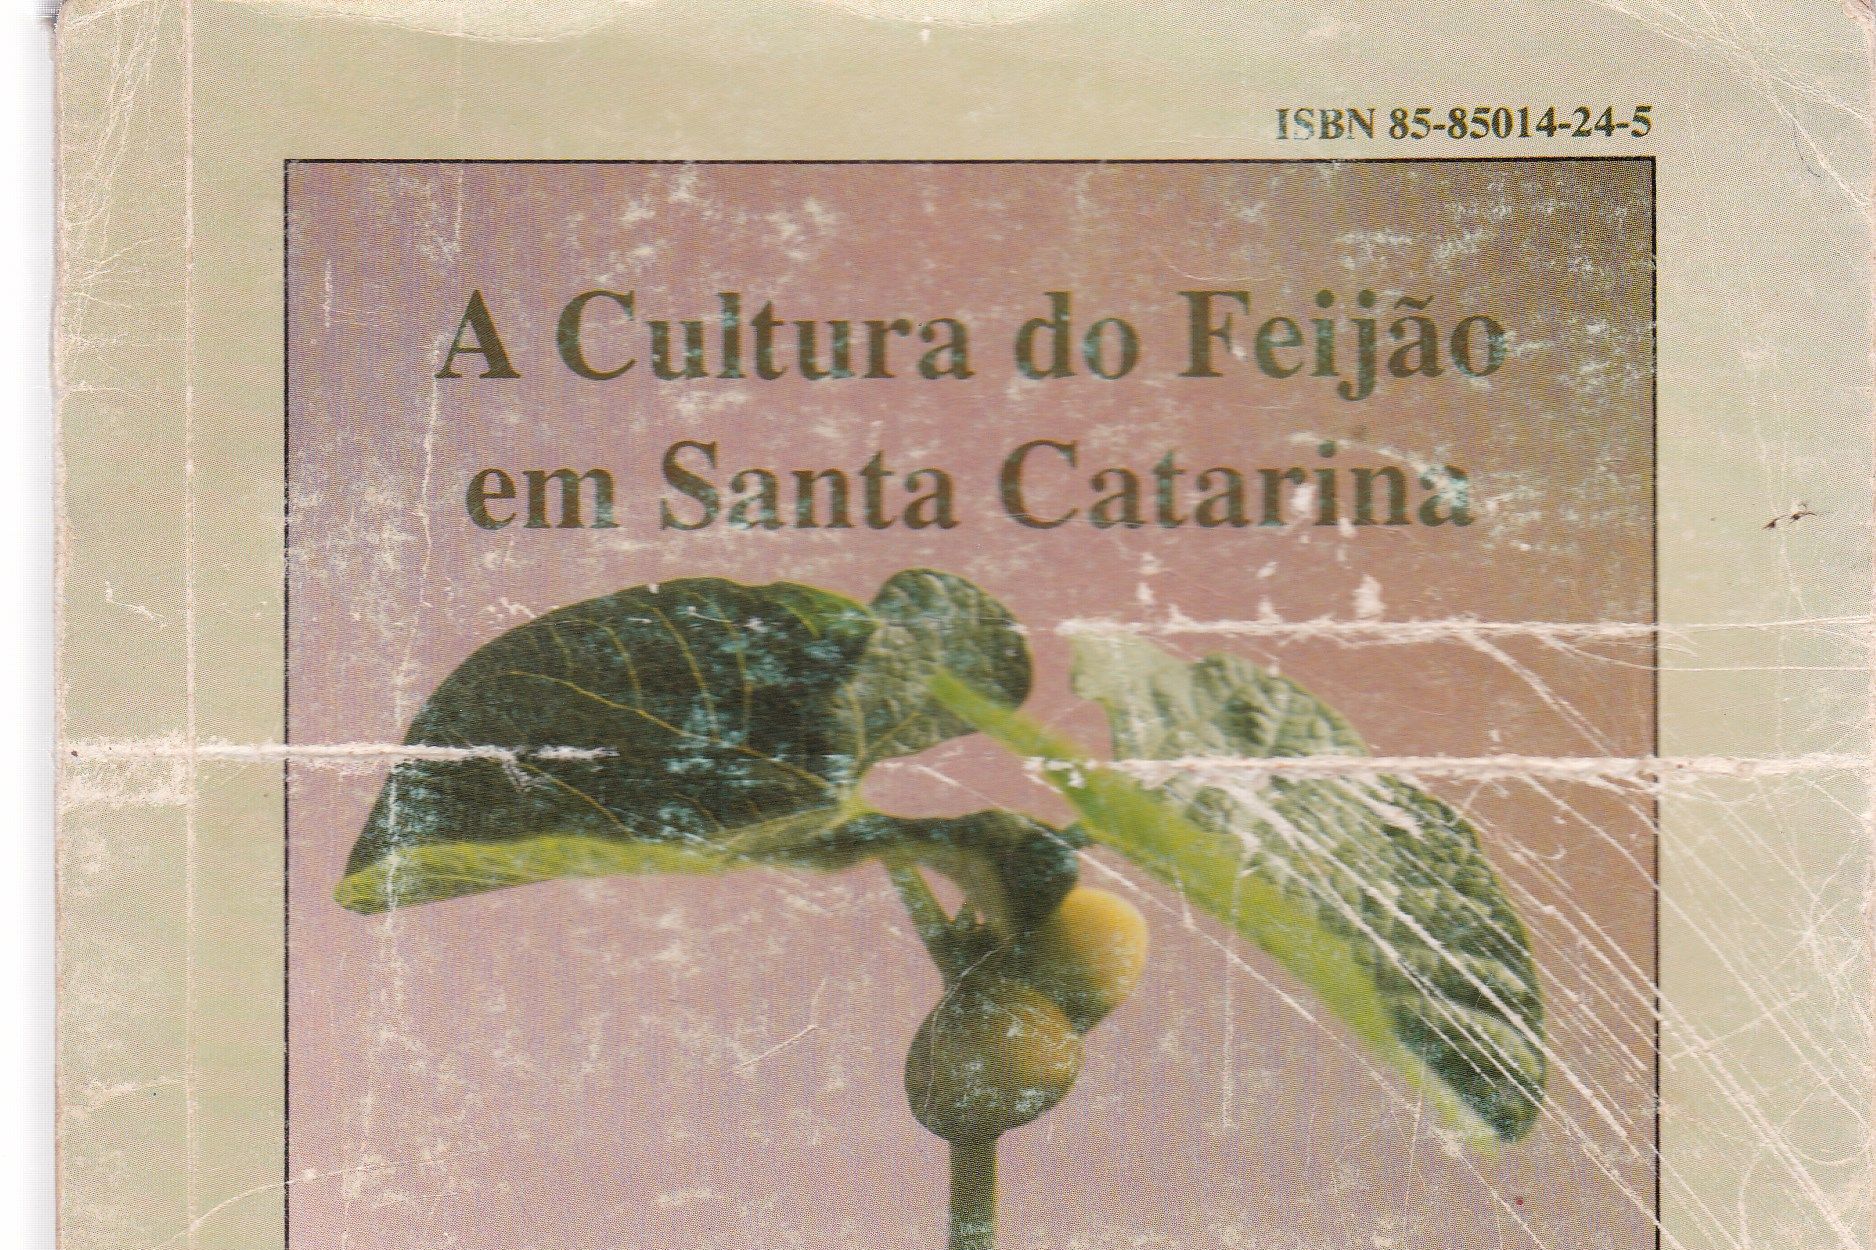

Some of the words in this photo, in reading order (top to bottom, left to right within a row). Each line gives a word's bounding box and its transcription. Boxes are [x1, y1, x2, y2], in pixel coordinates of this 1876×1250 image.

[1276, 107, 1376, 140] ISBN
[1389, 105, 1653, 139] 85-85014-24-5
[435, 289, 521, 379] A
[555, 289, 975, 381] Cultura
[1014, 290, 1141, 380] do
[1178, 289, 1509, 402] Feijão
[465, 466, 620, 531] em
[660, 439, 961, 532] Santa
[999, 438, 1475, 530] Catarina
